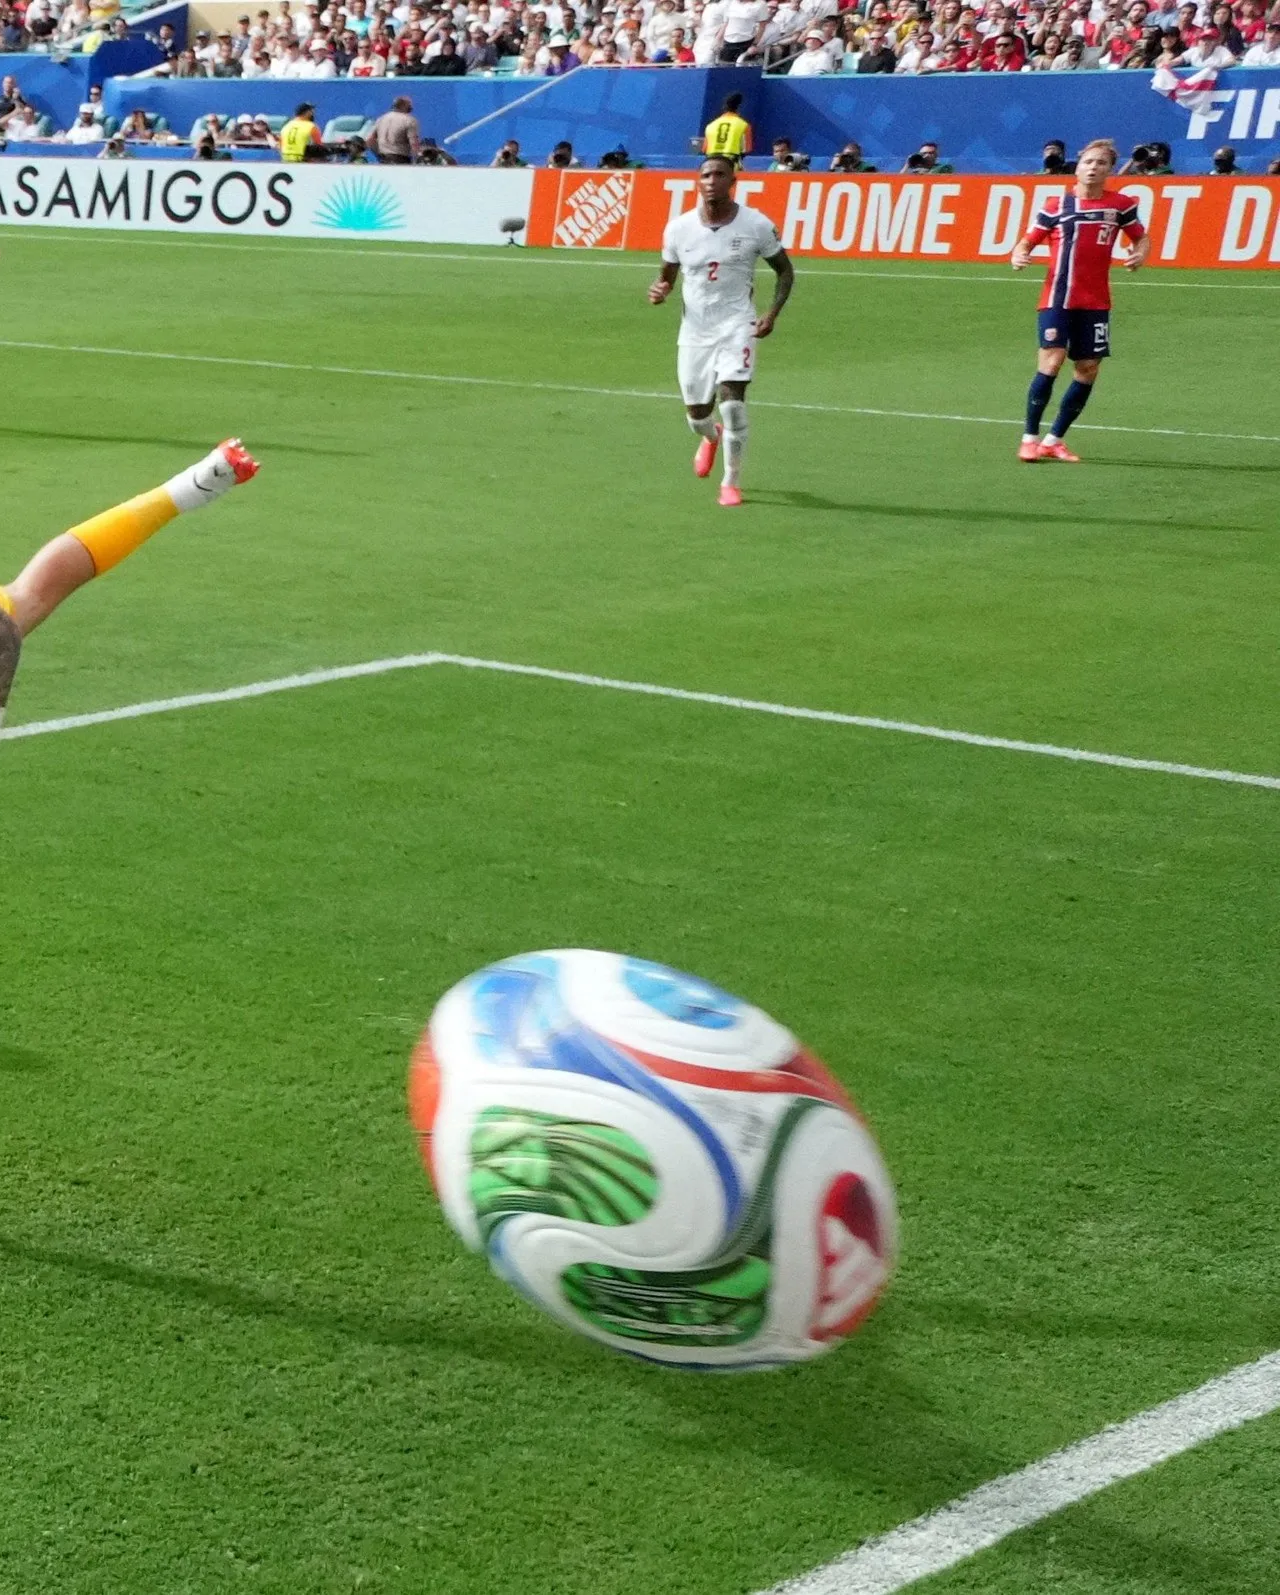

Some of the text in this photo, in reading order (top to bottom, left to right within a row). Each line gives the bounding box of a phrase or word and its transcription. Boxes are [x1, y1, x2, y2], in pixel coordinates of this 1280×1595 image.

[555, 171, 632, 246] HOME
[565, 177, 600, 209] THE
[581, 199, 628, 247] DEPOT
[781, 181, 961, 254] HOME
[978, 184, 1202, 261] DEOT
[1219, 185, 1280, 261] D
[707, 261, 720, 281] 2
[743, 347, 751, 368] 2
